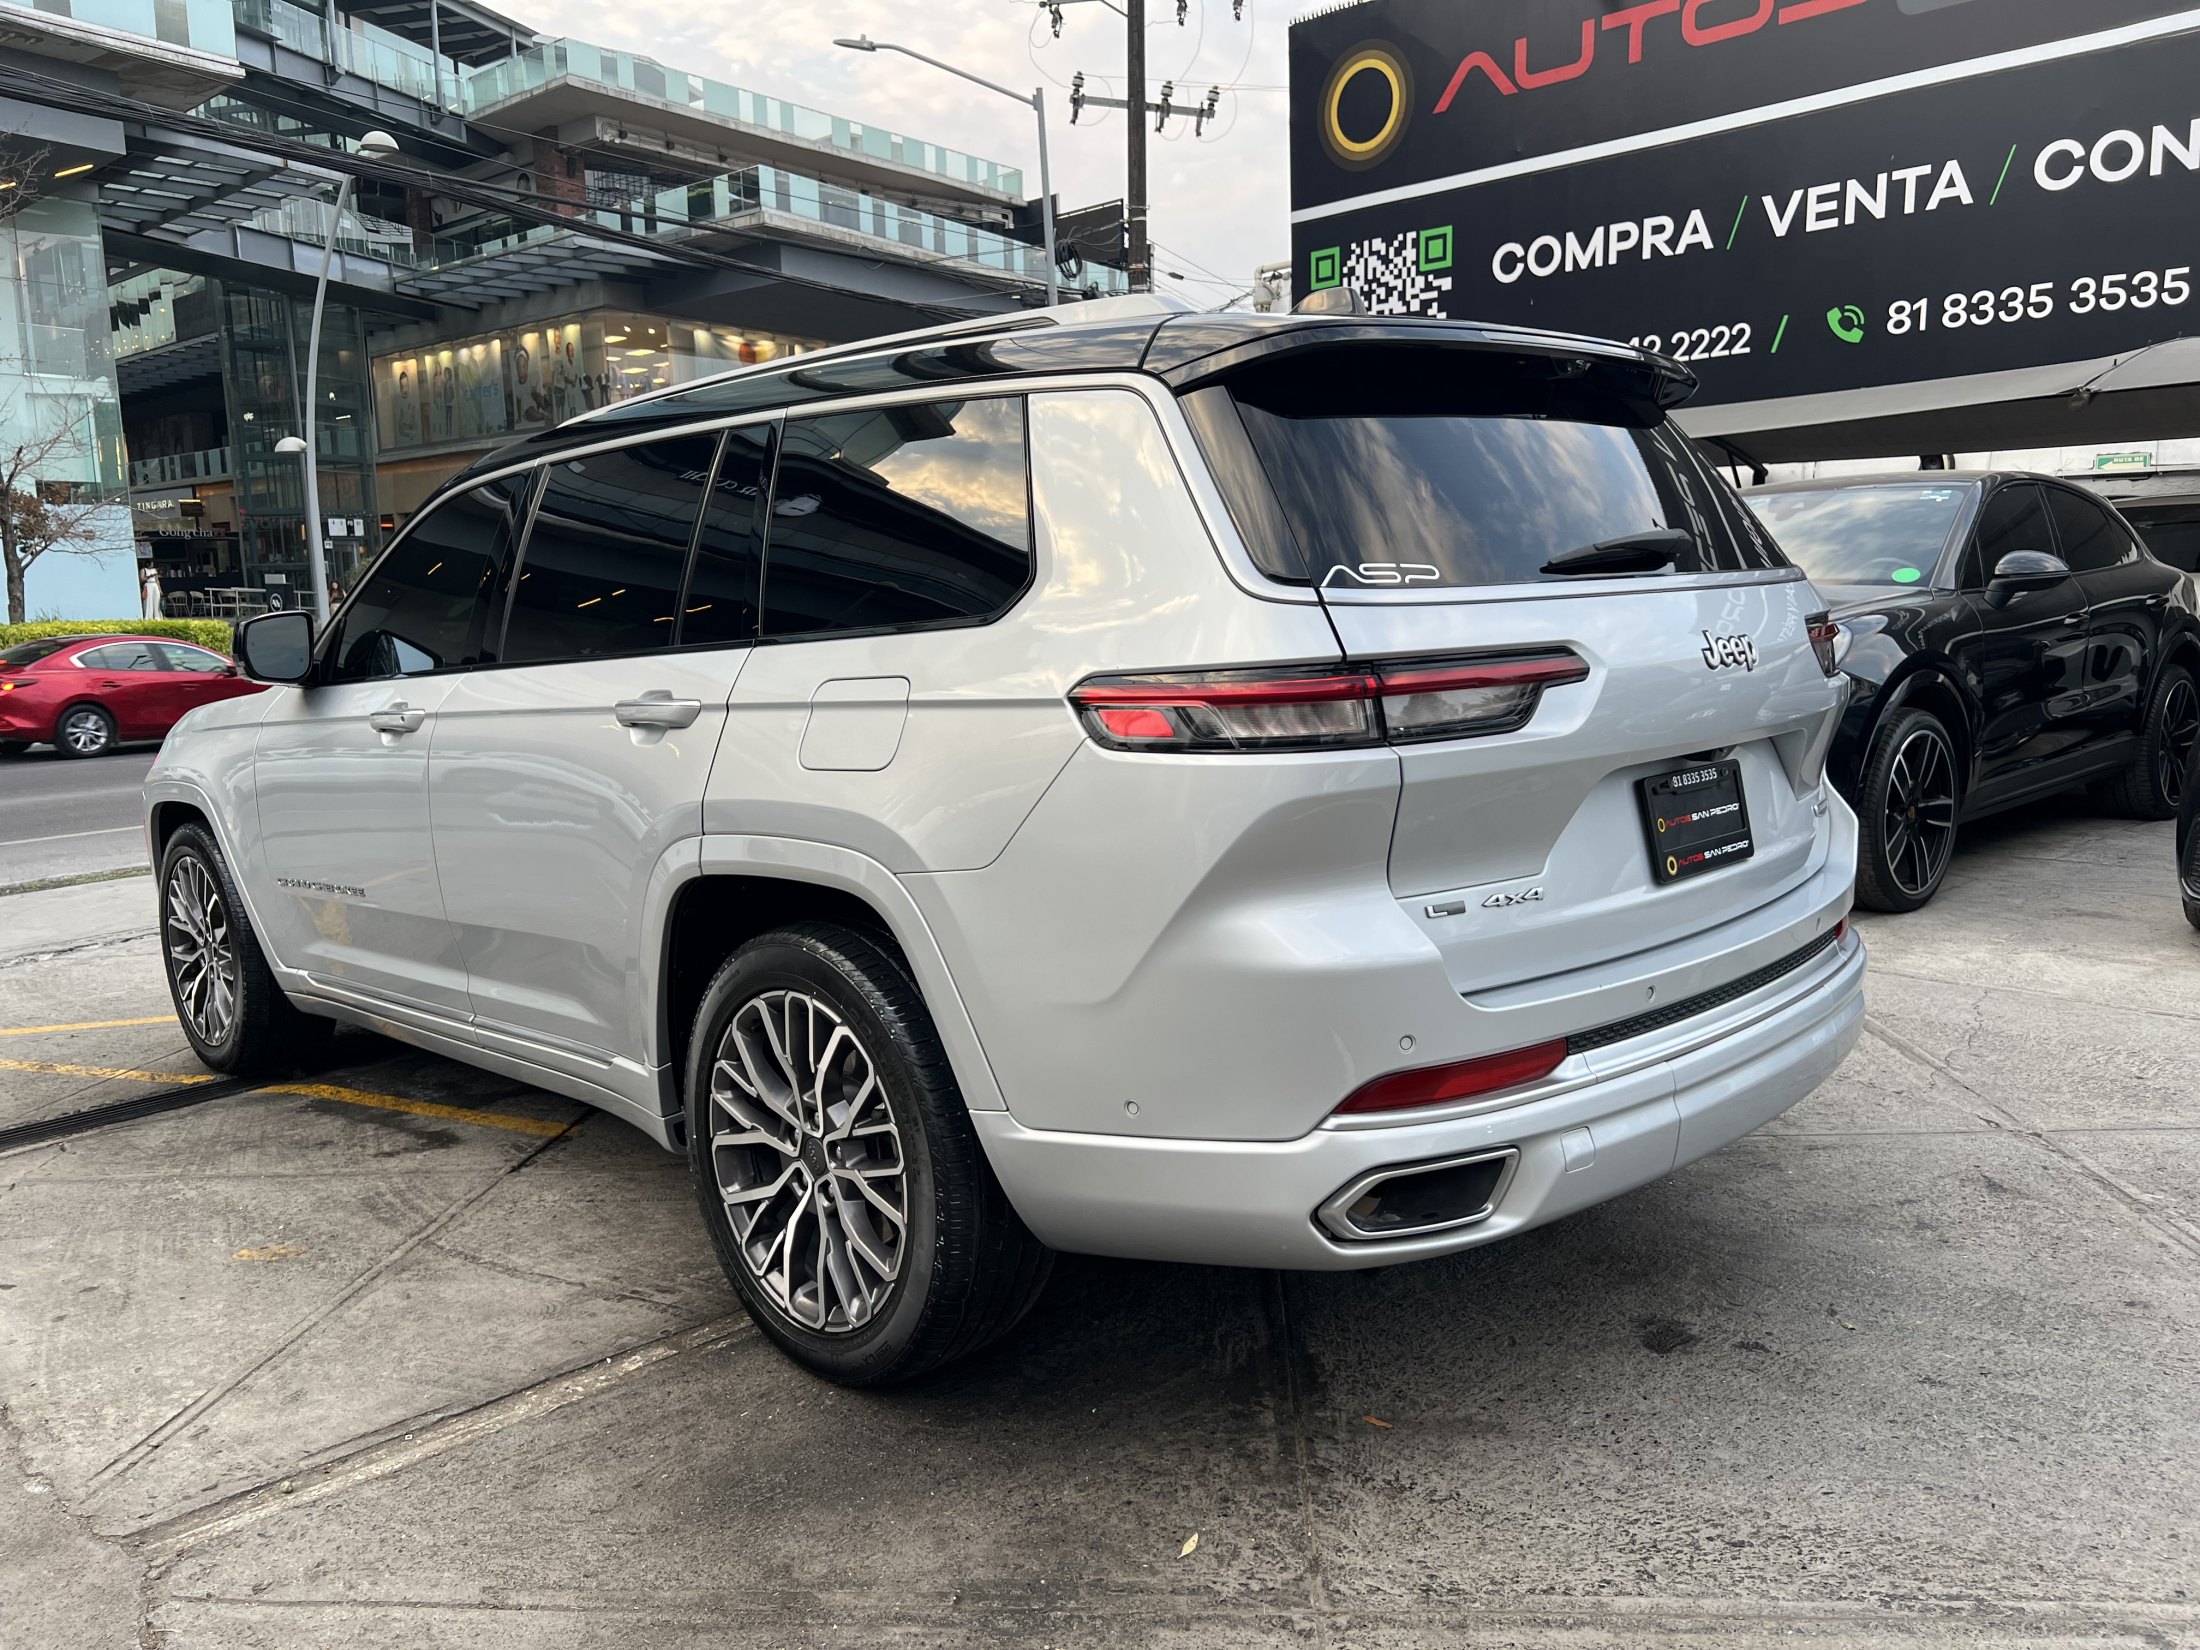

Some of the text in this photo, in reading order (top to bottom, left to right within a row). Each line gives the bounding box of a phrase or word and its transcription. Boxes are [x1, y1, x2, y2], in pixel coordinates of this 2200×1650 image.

[1492, 209, 1714, 283] COMPRA
[1761, 159, 1974, 237] VENTA
[2033, 118, 2200, 191] CON
[1670, 322, 1751, 362] 2222
[1886, 297, 1928, 335] 81
[1942, 282, 2054, 328] 8335
[2069, 266, 2190, 314] 3535
[137, 499, 174, 511] ZINGARA
[159, 526, 192, 540] Gong
[1321, 562, 1441, 588] ASP
[1701, 629, 1758, 673] Jeep
[1672, 768, 1718, 788] 81 8335 3535
[1665, 803, 1739, 830] AUTOS SAN PEDRO
[1678, 840, 1749, 868] AUTOS SAN PEDRO
[1481, 886, 1545, 908] 4x4
